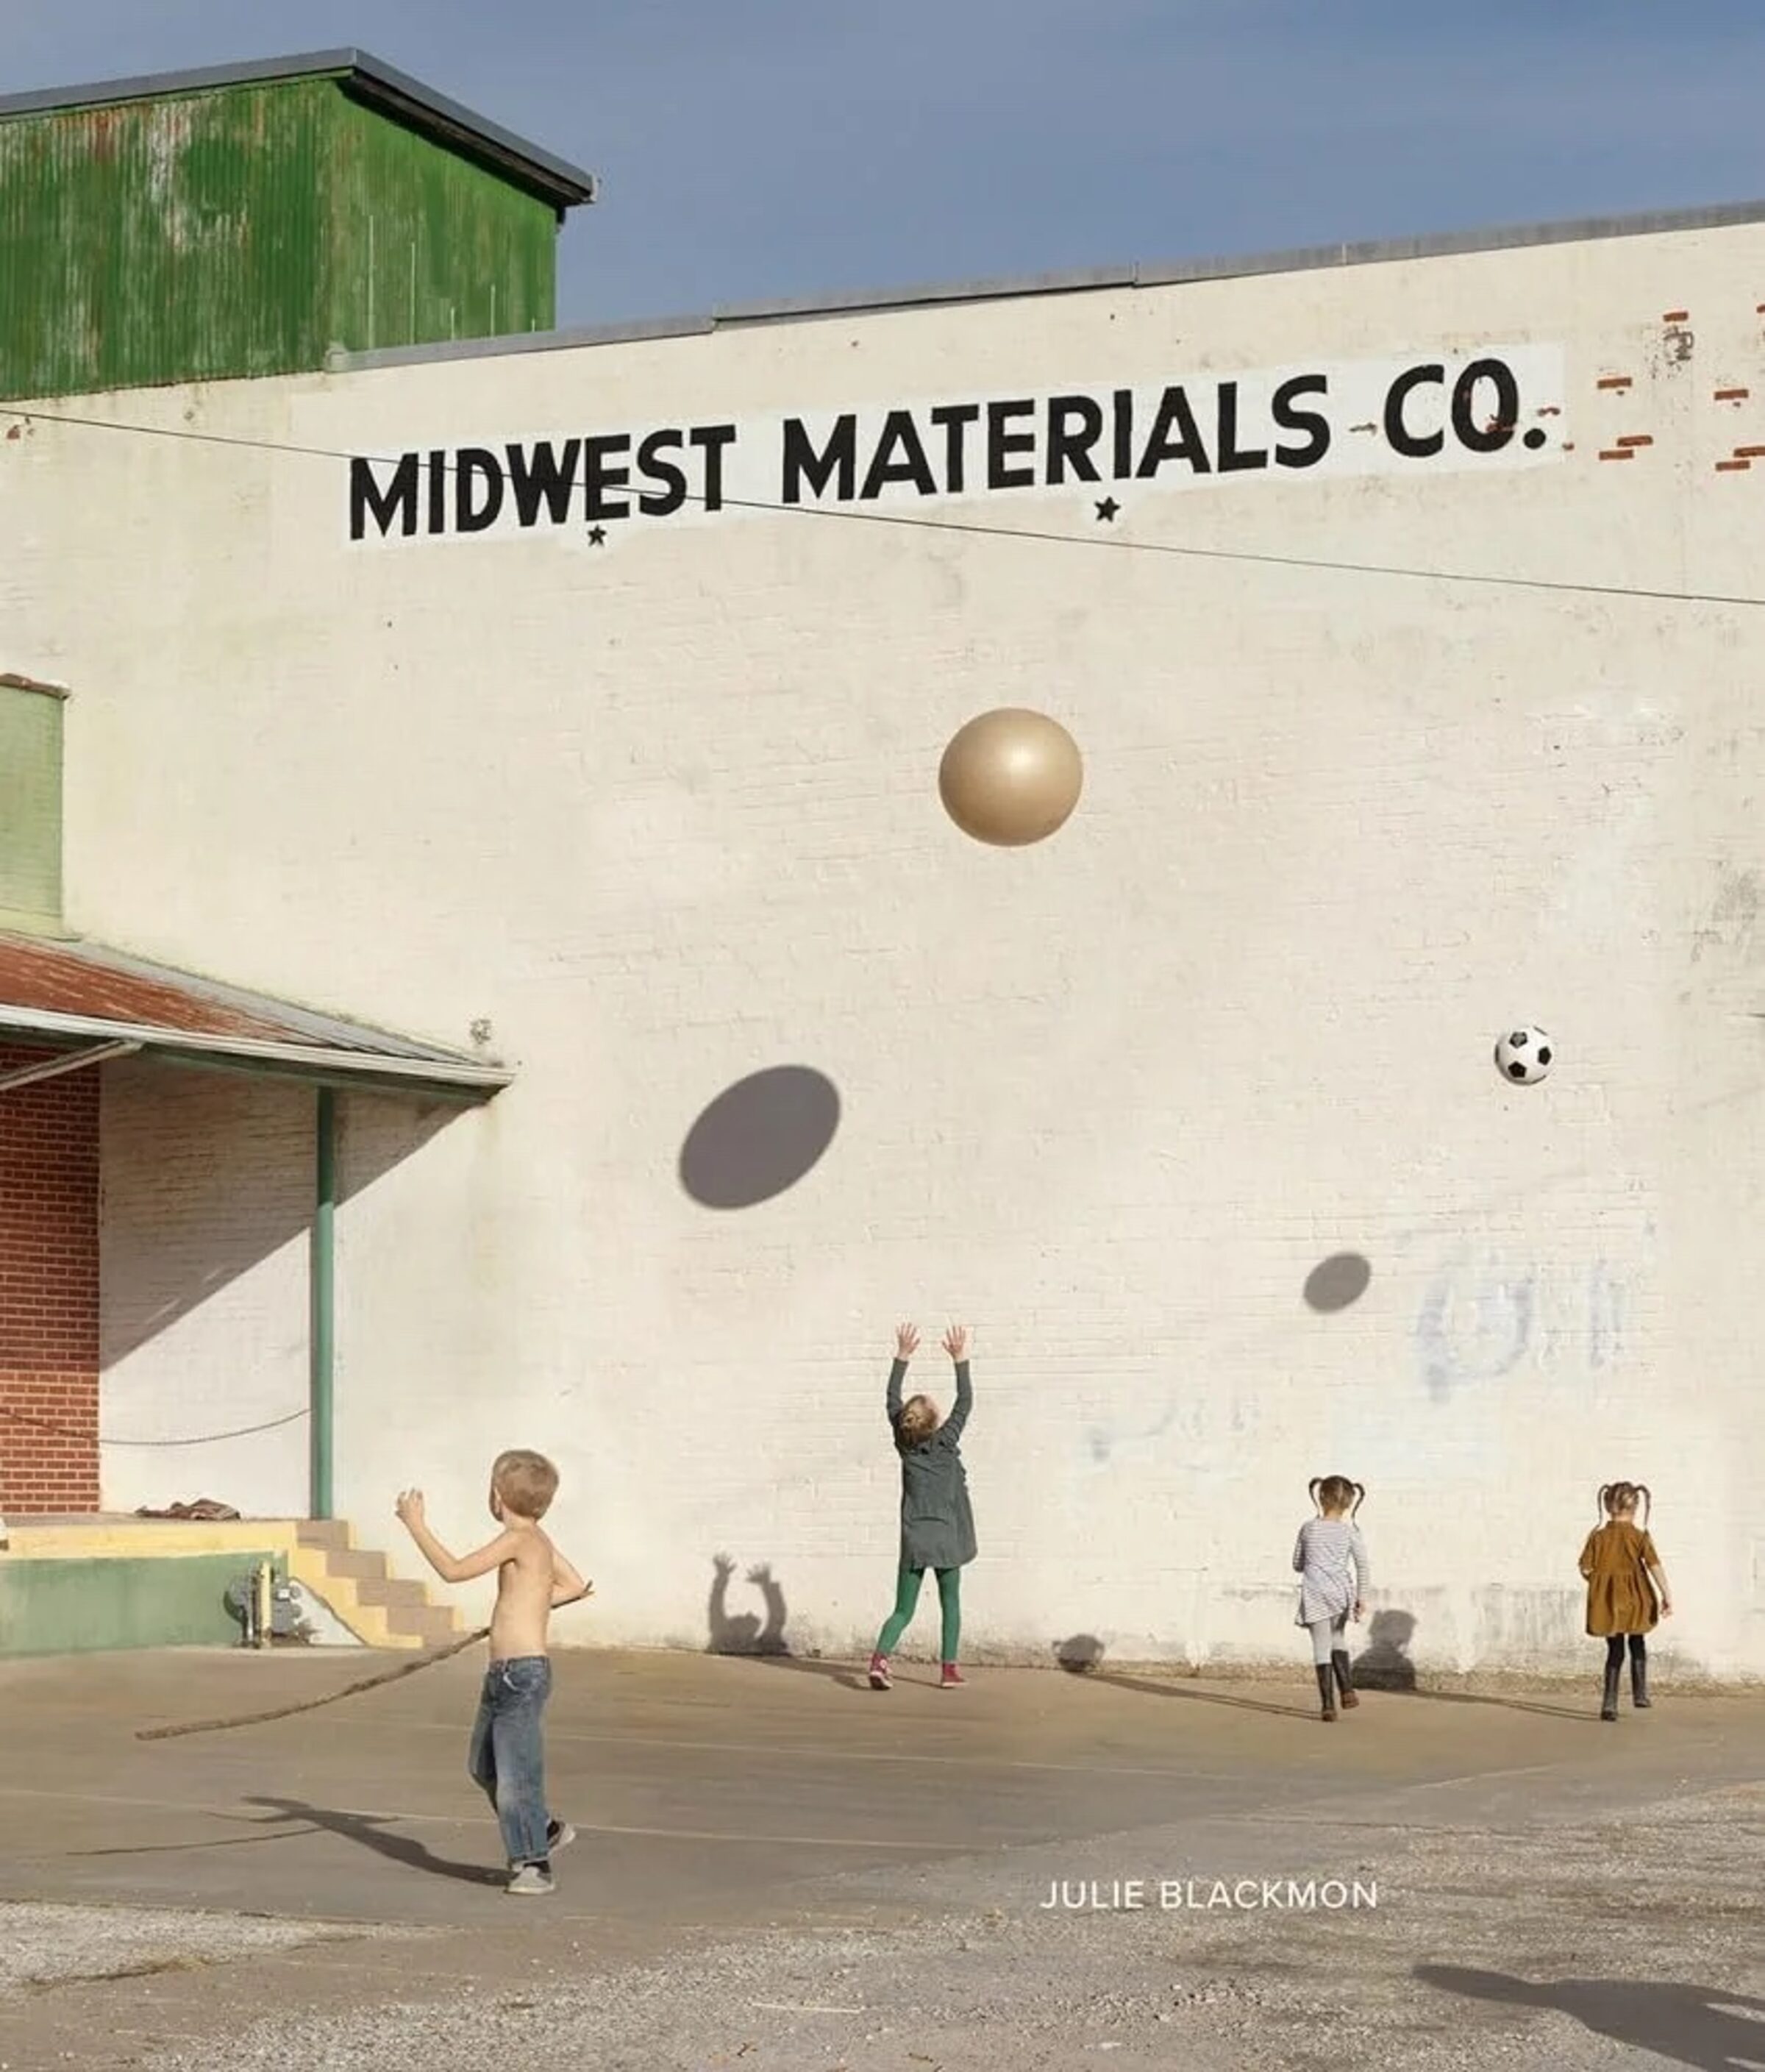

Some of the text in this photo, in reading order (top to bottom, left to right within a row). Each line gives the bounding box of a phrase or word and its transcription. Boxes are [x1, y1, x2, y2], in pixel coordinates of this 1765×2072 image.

[349, 357, 1547, 541] MIDWEST MATERIALS CO.
